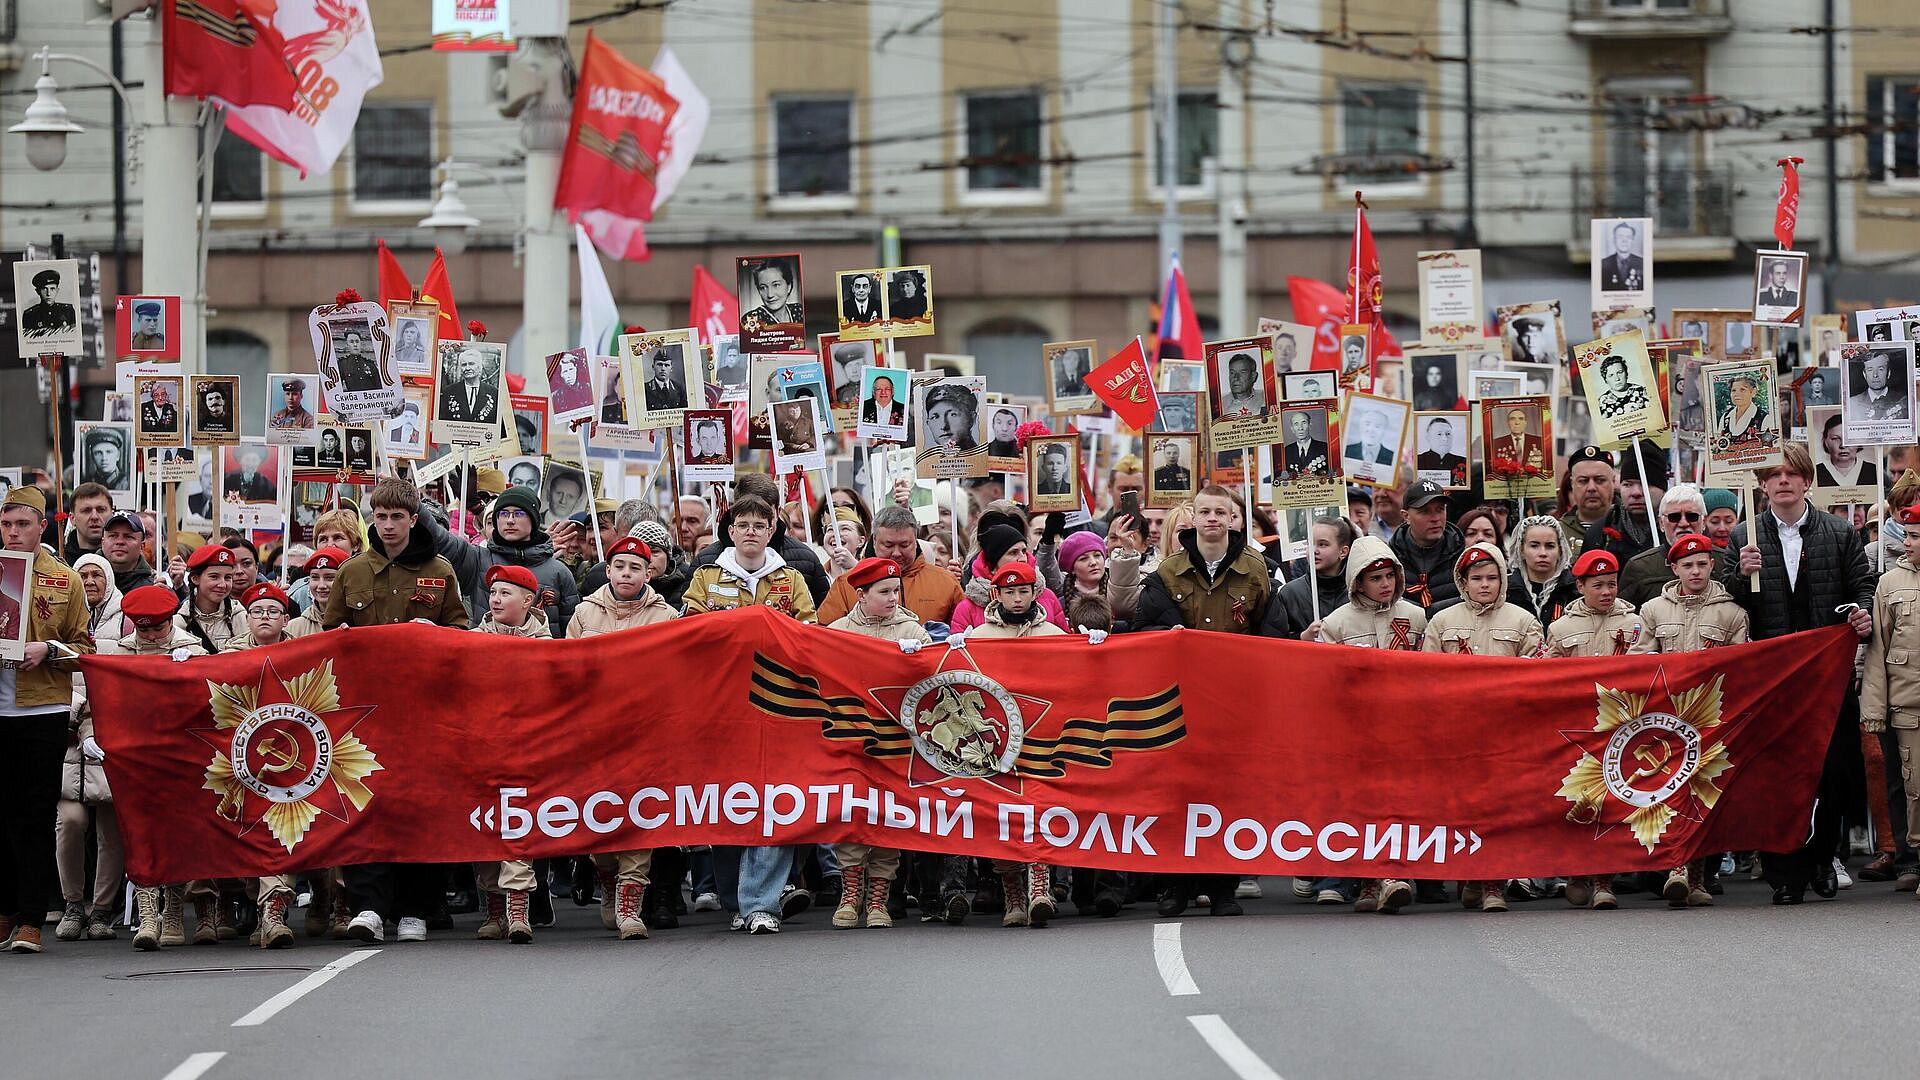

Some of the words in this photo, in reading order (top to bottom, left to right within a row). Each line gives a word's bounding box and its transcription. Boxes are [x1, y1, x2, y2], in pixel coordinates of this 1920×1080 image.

[334, 393, 359, 402] Скиба
[363, 390, 396, 400] Василий
[340, 400, 395, 411] Валерьянович
[963, 673, 1003, 697] ПОЛК
[236, 705, 318, 795] ОТЕЧЕСТВЕННАЯ
[1607, 715, 1697, 800] ОТЕЧЕСТВЕННАЯ
[469, 781, 974, 840] «Бессмертный
[998, 803, 1159, 857] полк
[1184, 803, 1482, 863] России»
